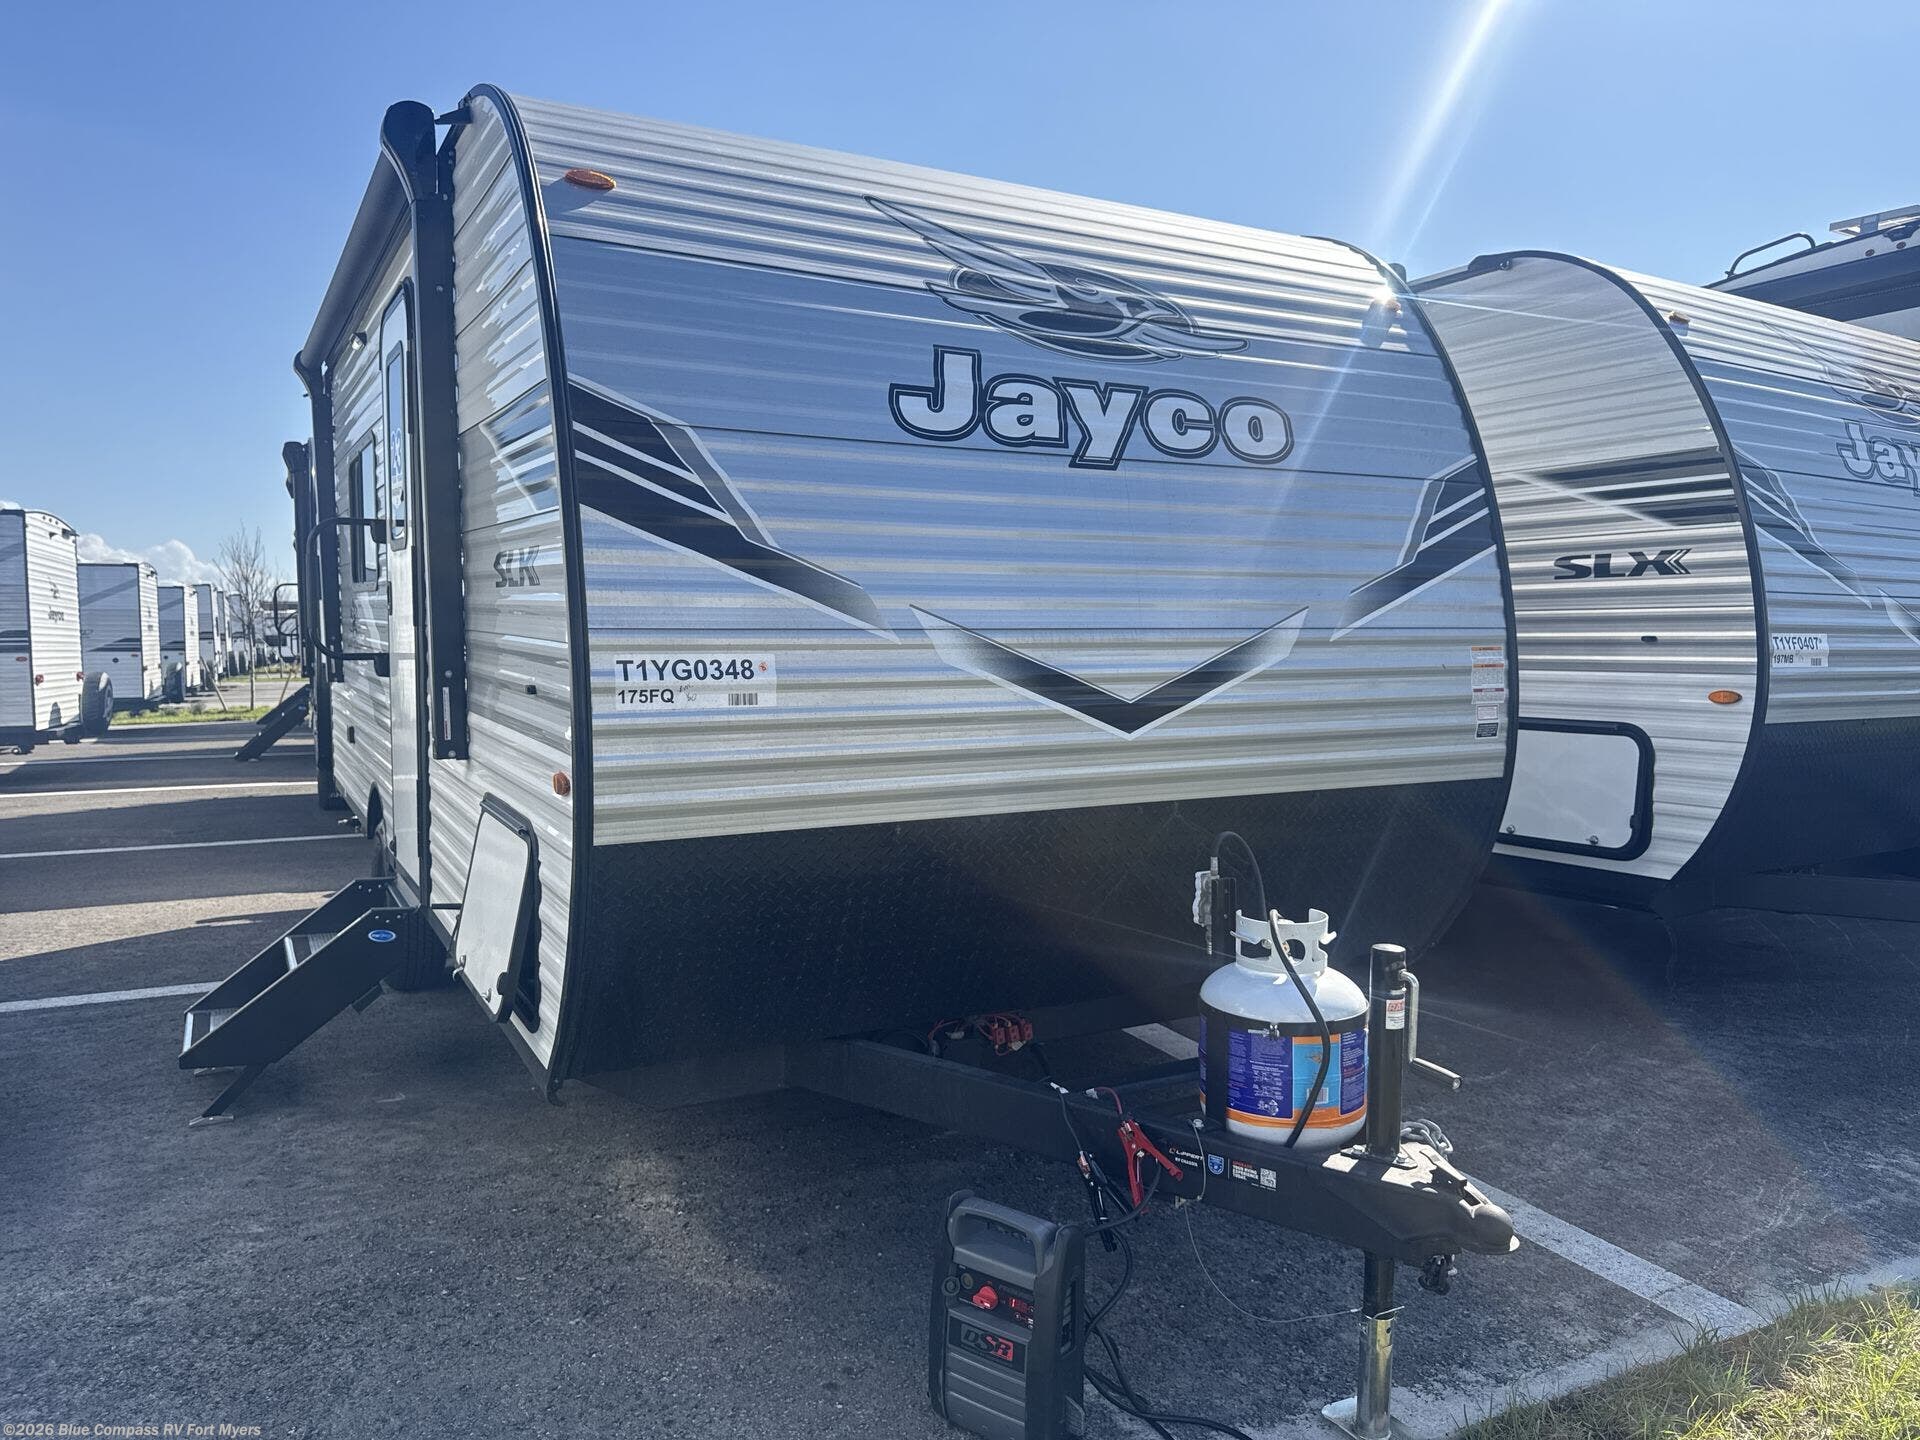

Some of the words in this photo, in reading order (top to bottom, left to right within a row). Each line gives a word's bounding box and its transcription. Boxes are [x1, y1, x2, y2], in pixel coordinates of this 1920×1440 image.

[888, 343, 1295, 470] Jayco
[1554, 548, 1692, 580] SLX
[1772, 636, 1819, 650] T1YF0407
[615, 658, 755, 682] T1YG0348
[618, 688, 675, 704] 175FQ
